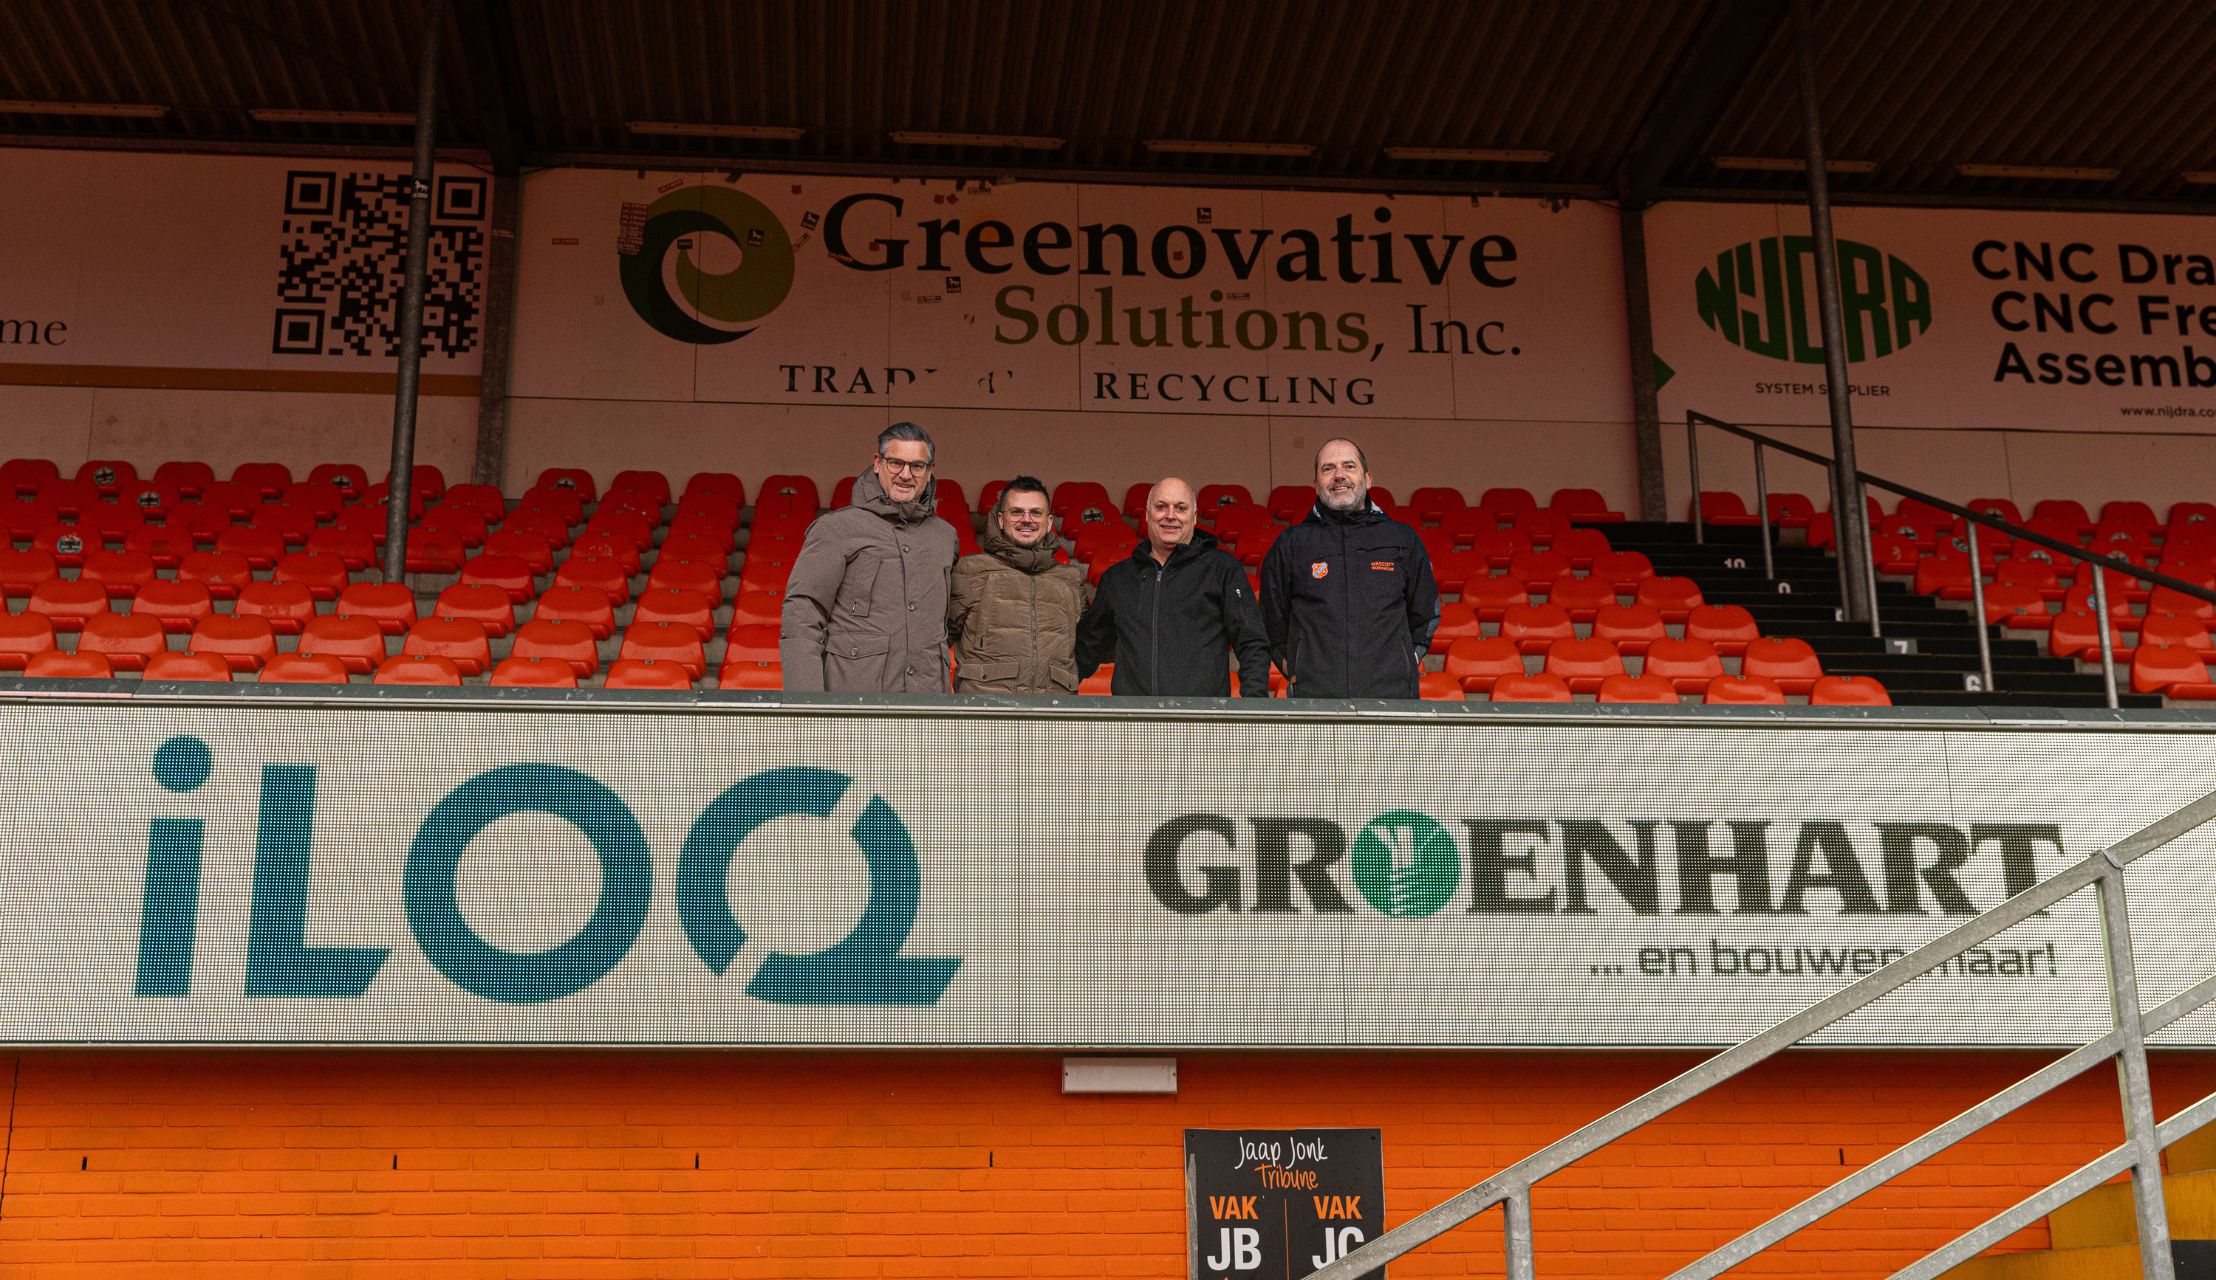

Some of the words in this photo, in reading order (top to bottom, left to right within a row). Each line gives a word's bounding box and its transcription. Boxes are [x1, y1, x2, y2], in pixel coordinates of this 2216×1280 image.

[823, 194, 1518, 289] Greenovative
[1972, 239, 2096, 284] CNC
[994, 284, 1385, 362] Solutions,
[1406, 302, 1522, 357] Inc.
[1992, 291, 2118, 335] CNC
[1994, 342, 2216, 388] Assemb
[1094, 371, 1376, 406] RECYCLING
[1755, 382, 1814, 395] SYSTEM
[1818, 384, 1890, 397] SPLIER
[2120, 405, 2216, 418] www.nijdra.co
[1966, 675, 1982, 691] 6
[134, 735, 963, 1006] iLOQ
[1639, 945, 1697, 976] en
[1234, 1136, 1281, 1169] Jaap
[1285, 1136, 1328, 1169] Jonk
[1254, 1163, 1319, 1190] Tribune
[1209, 1196, 1259, 1220] VAK
[1313, 1196, 1362, 1220] VAK
[1207, 1227, 1262, 1271] JB
